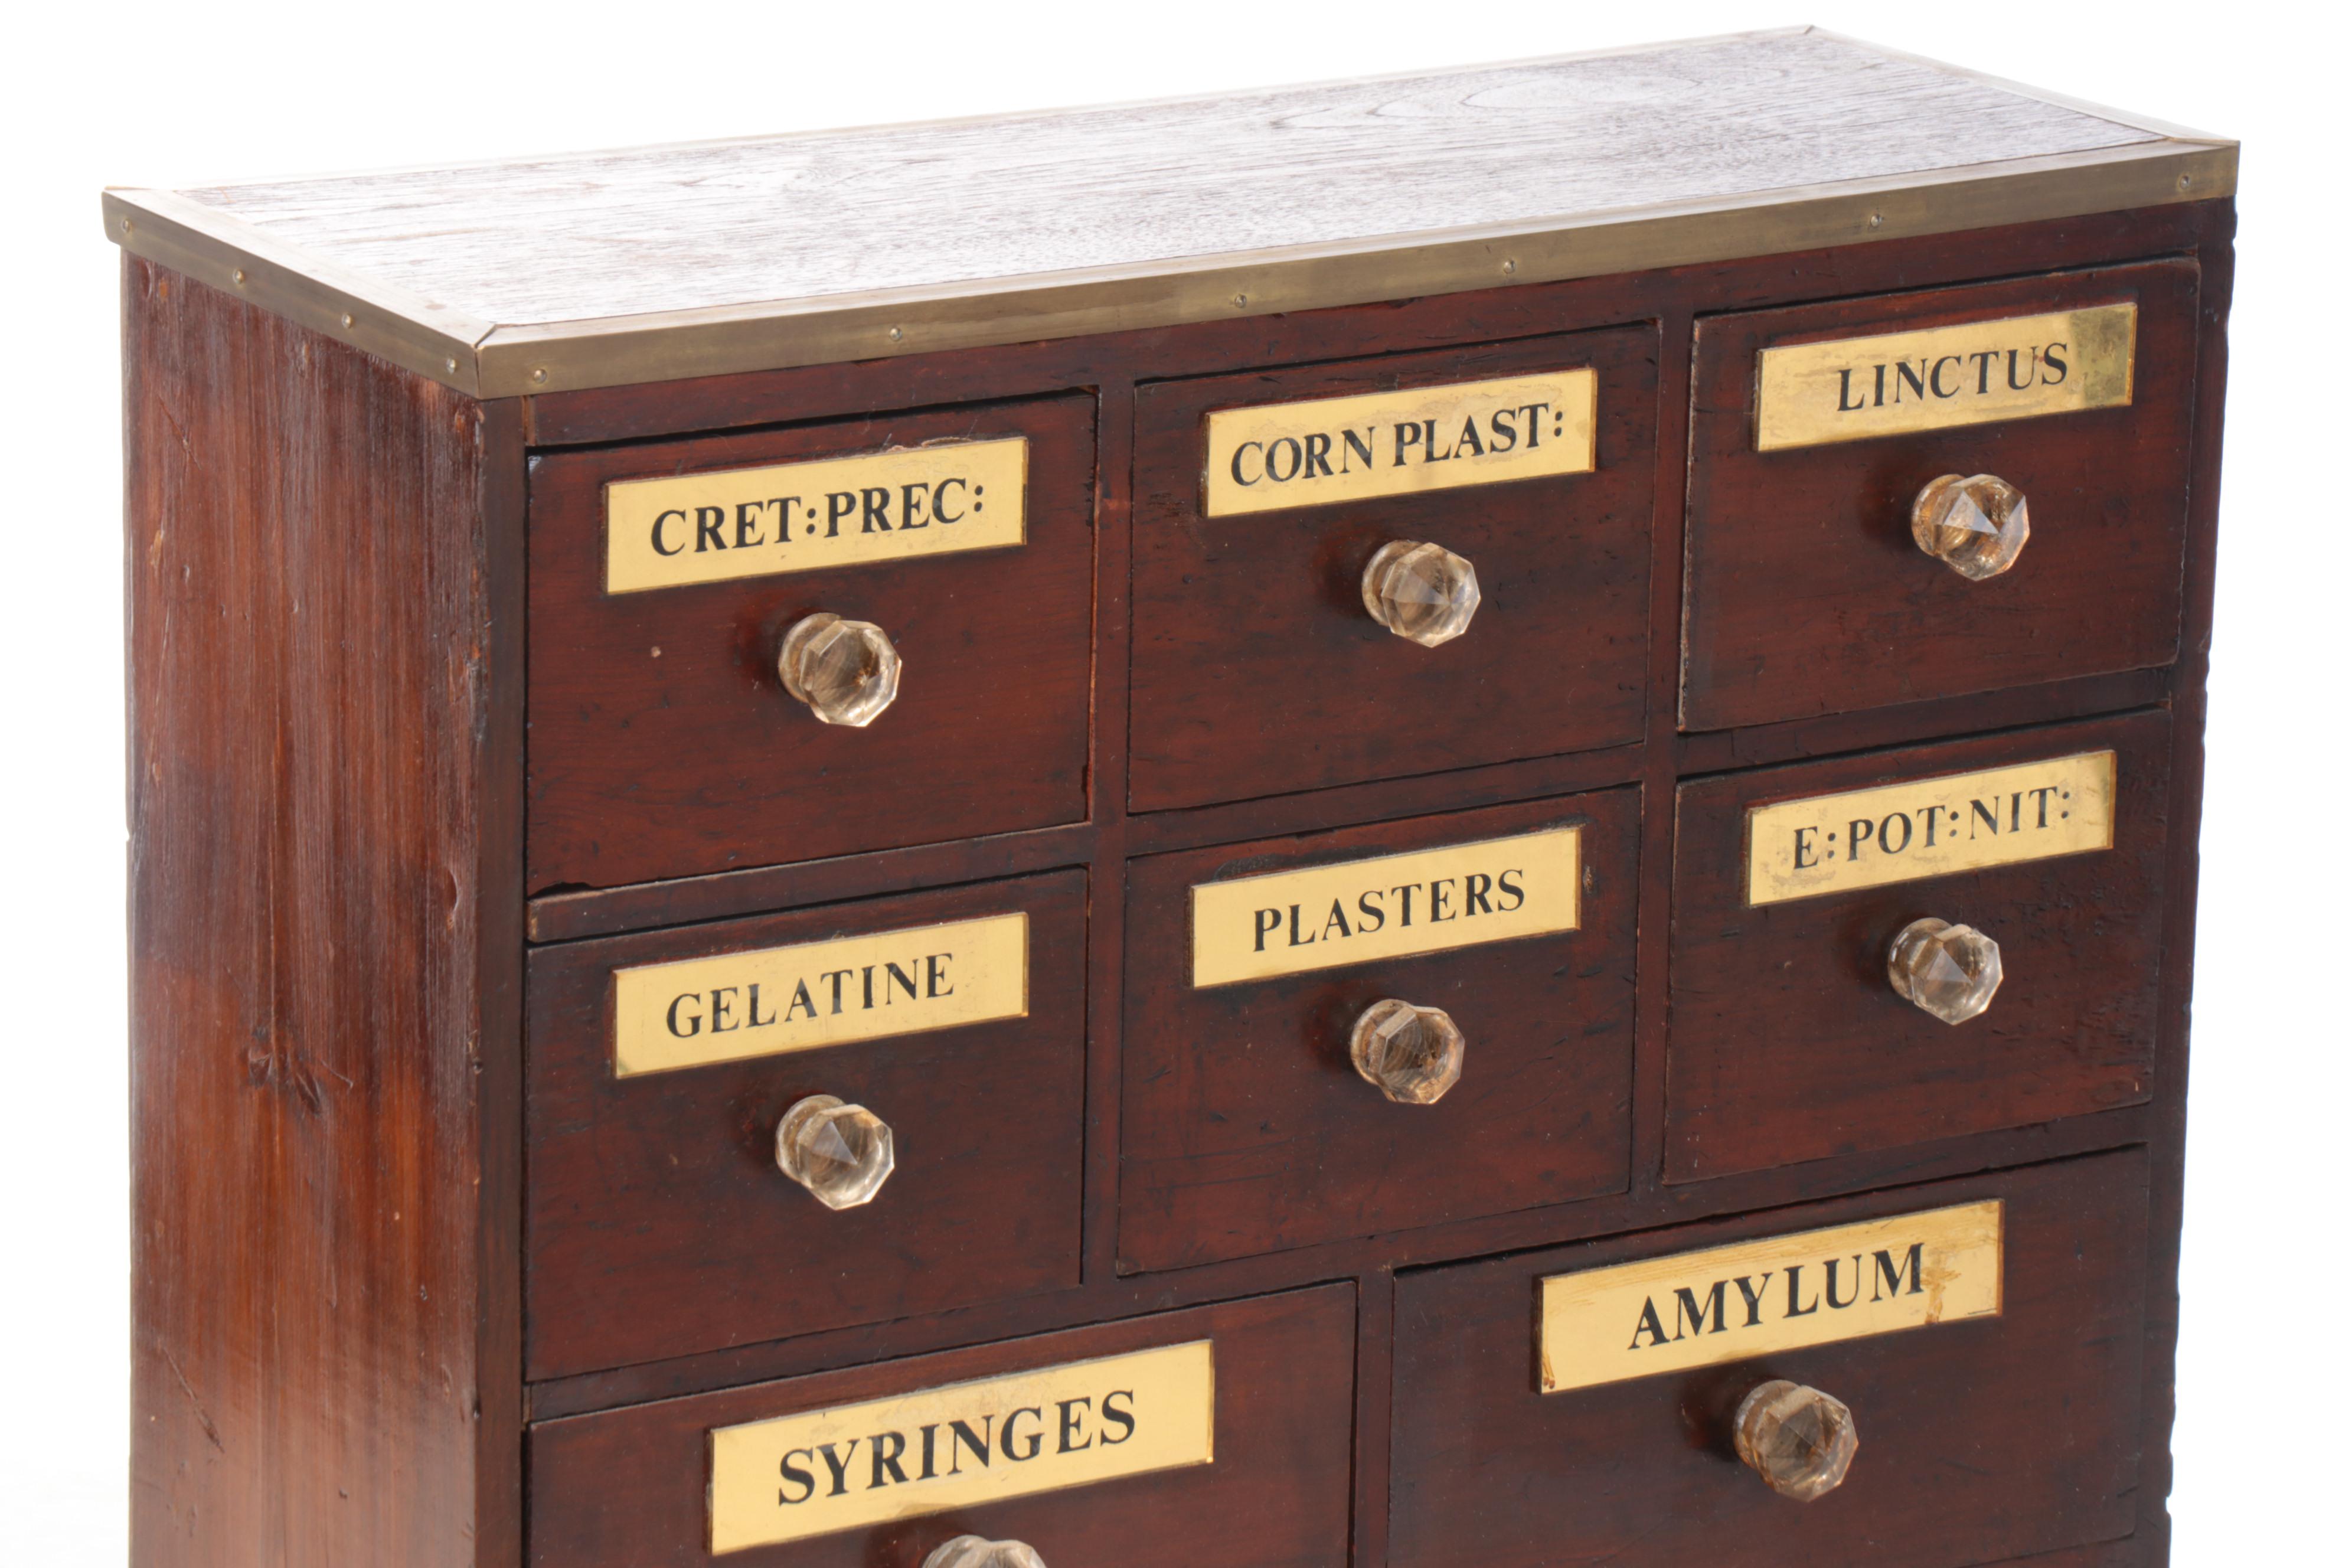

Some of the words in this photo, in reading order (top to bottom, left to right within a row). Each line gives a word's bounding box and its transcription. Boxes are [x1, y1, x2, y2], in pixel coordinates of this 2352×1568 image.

[1837, 342, 2068, 412] LINCTUS
[1230, 429, 1372, 486] CORN
[1392, 402, 1563, 468] PLAST:
[1254, 870, 1525, 952] PLASTERS
[666, 952, 955, 1038] GELATINE
[1628, 1242, 1925, 1350] AMYLUM
[778, 1390, 1135, 1505] SYRINGES
